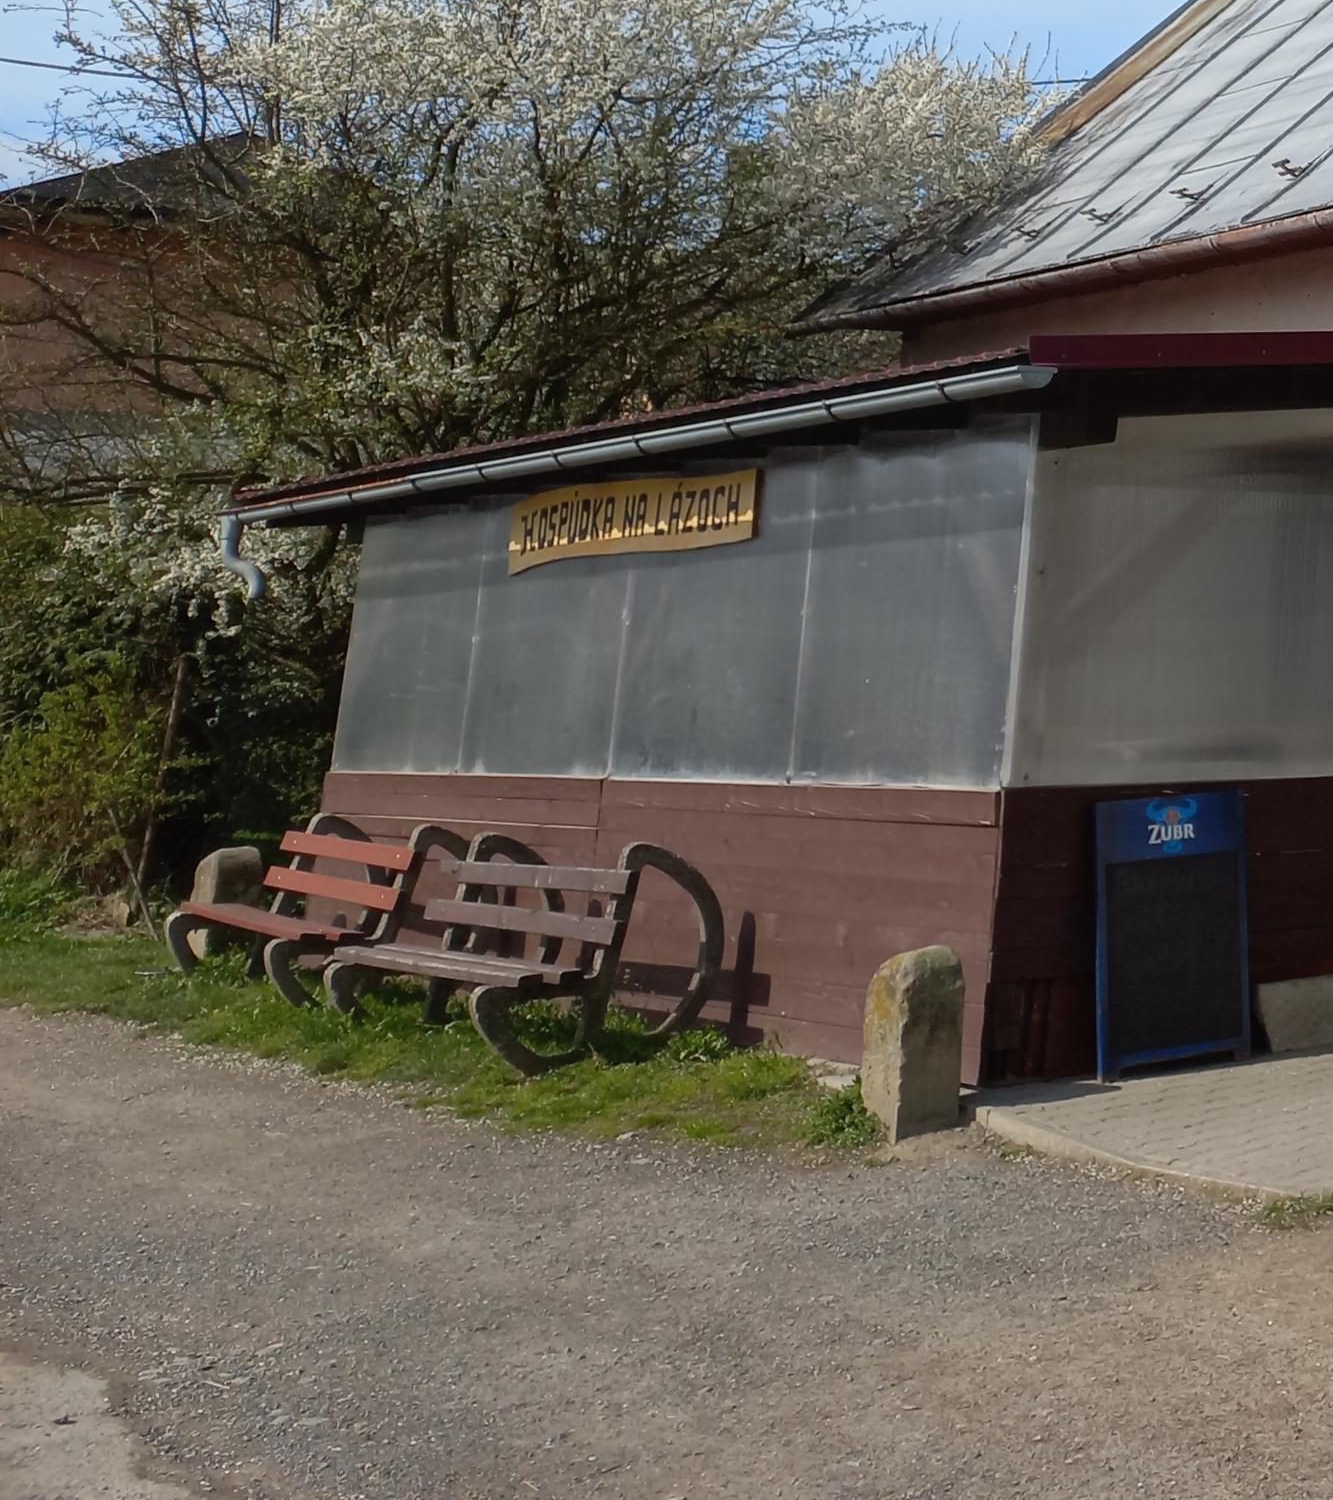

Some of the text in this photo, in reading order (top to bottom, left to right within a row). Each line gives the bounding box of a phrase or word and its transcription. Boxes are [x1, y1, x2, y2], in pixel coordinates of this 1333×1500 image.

[623, 492, 648, 538] NA
[653, 482, 742, 537] LÁZOCH
[1147, 823, 1195, 844] ZUBR
